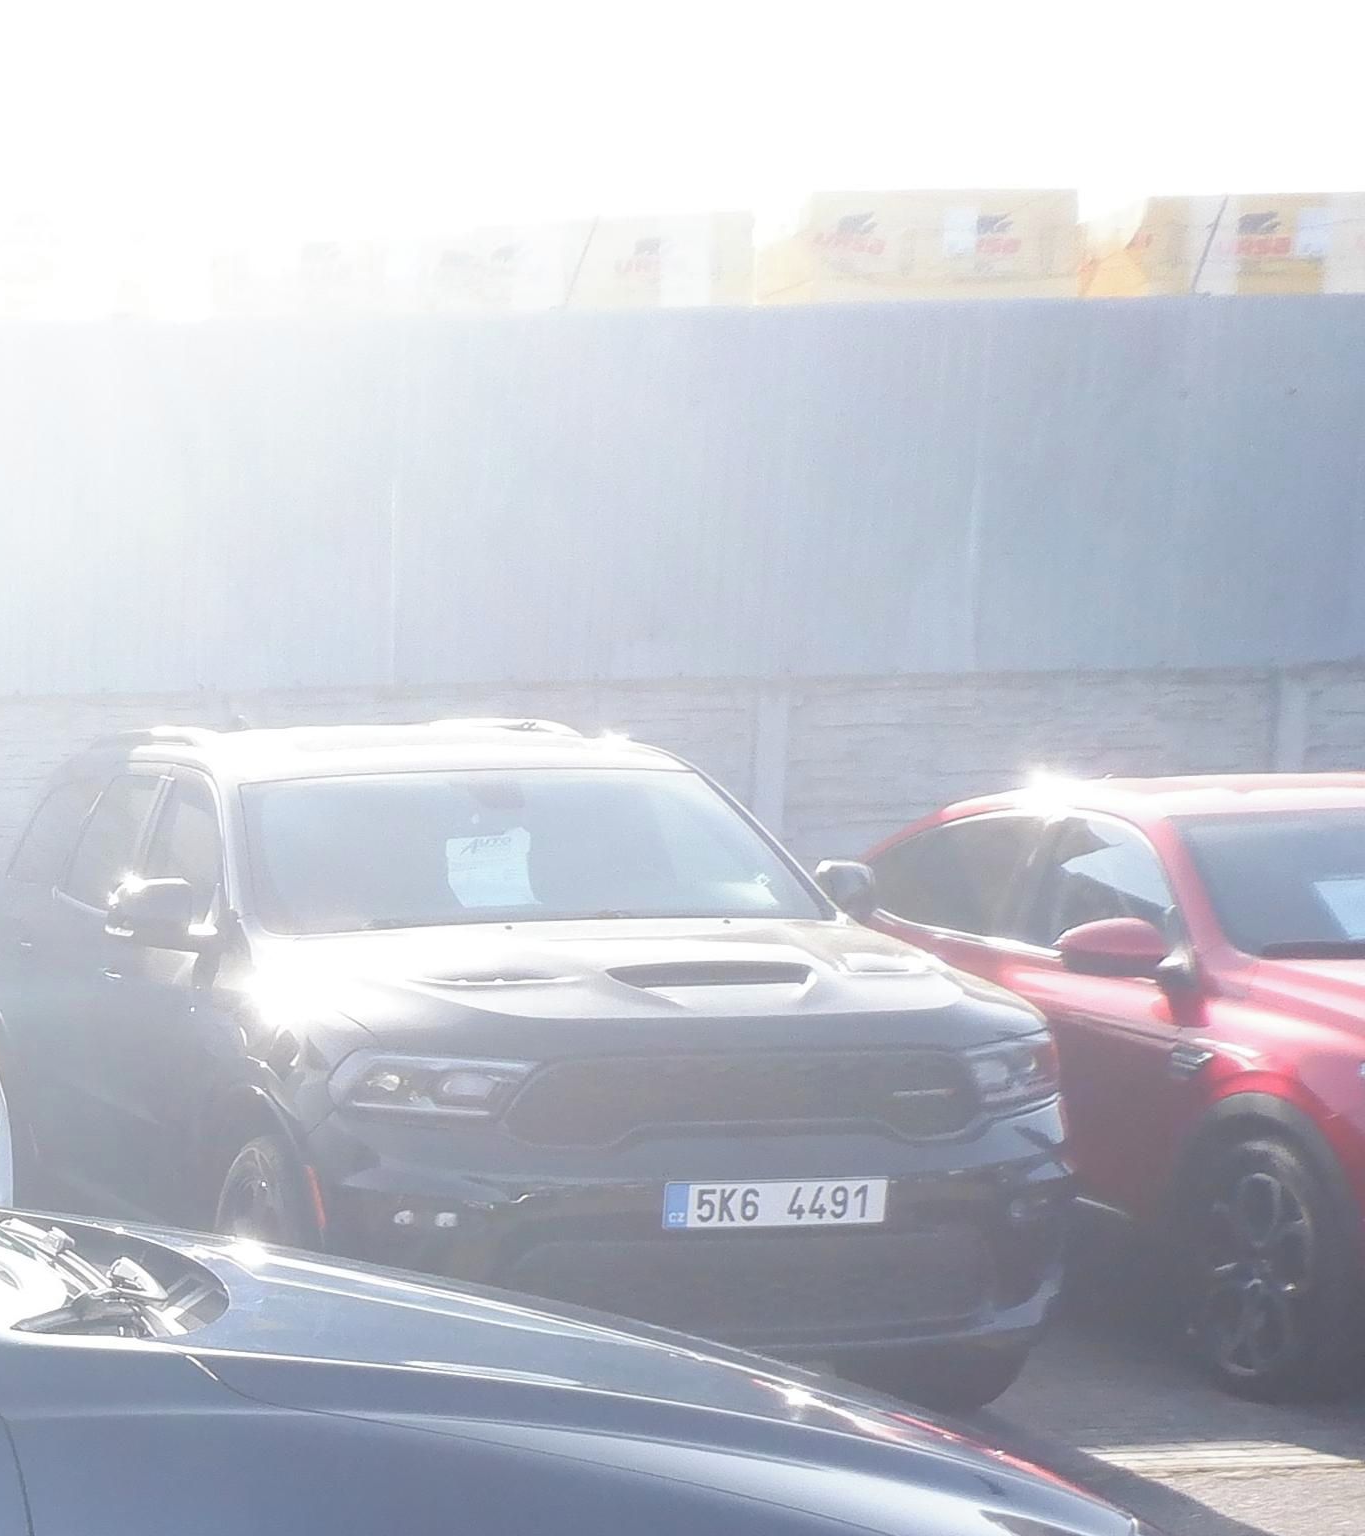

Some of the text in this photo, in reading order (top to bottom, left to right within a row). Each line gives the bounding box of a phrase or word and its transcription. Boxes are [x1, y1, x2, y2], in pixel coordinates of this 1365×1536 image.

[696, 1184, 869, 1223] 5K6 4491
[668, 1212, 685, 1223] CZ
